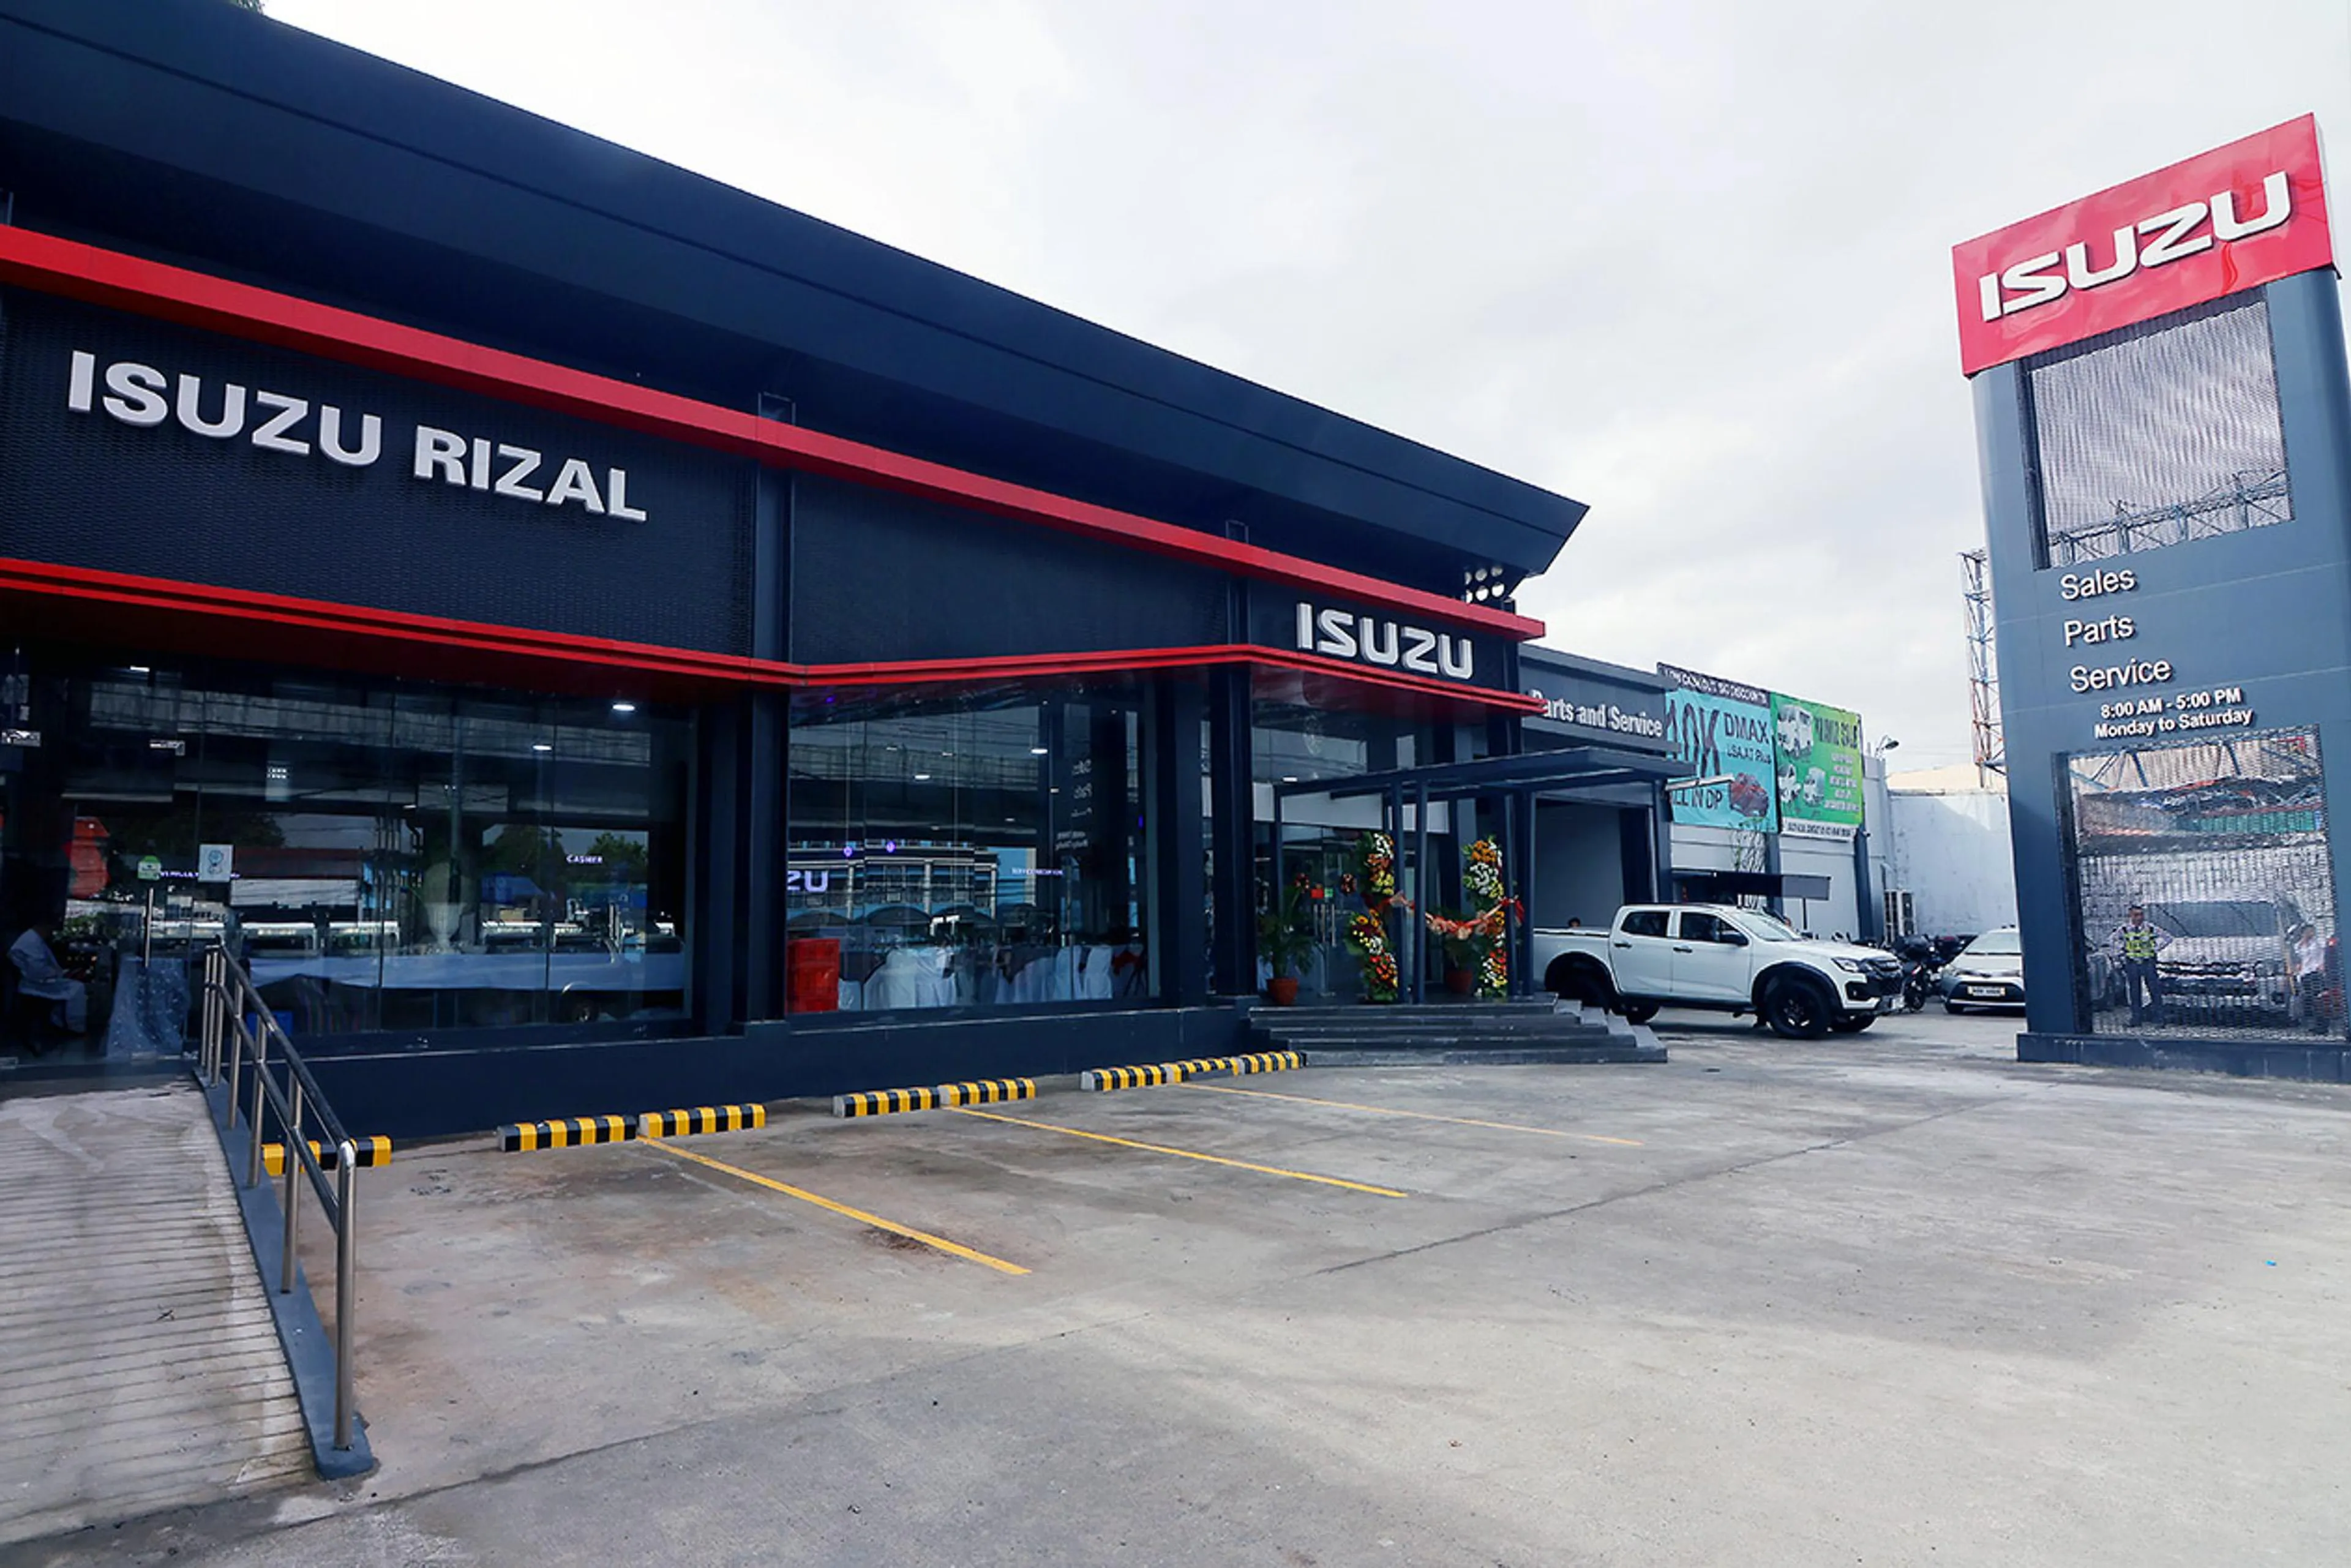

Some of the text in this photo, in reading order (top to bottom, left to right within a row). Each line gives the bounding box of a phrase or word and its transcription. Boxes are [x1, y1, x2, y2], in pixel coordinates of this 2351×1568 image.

[1979, 171, 2292, 322] ISUZU
[68, 350, 647, 522] ISUZU RIZAL
[2060, 569, 2136, 601] Sales
[1296, 602, 1473, 680] ISUZU
[2064, 614, 2135, 647] Parts
[2069, 658, 2172, 692] Service
[2101, 703, 2135, 719] 8:00
[2136, 698, 2162, 715] AM
[2176, 692, 2211, 710] 5:00
[2214, 687, 2242, 705] PM
[1576, 704, 1607, 728] and
[1608, 705, 1663, 737] Service
[1723, 712, 1769, 745] DMAX
[2094, 708, 2254, 739] Monday to Saturday
[1670, 787, 1689, 806] LL
[1706, 787, 1723, 809] DP
